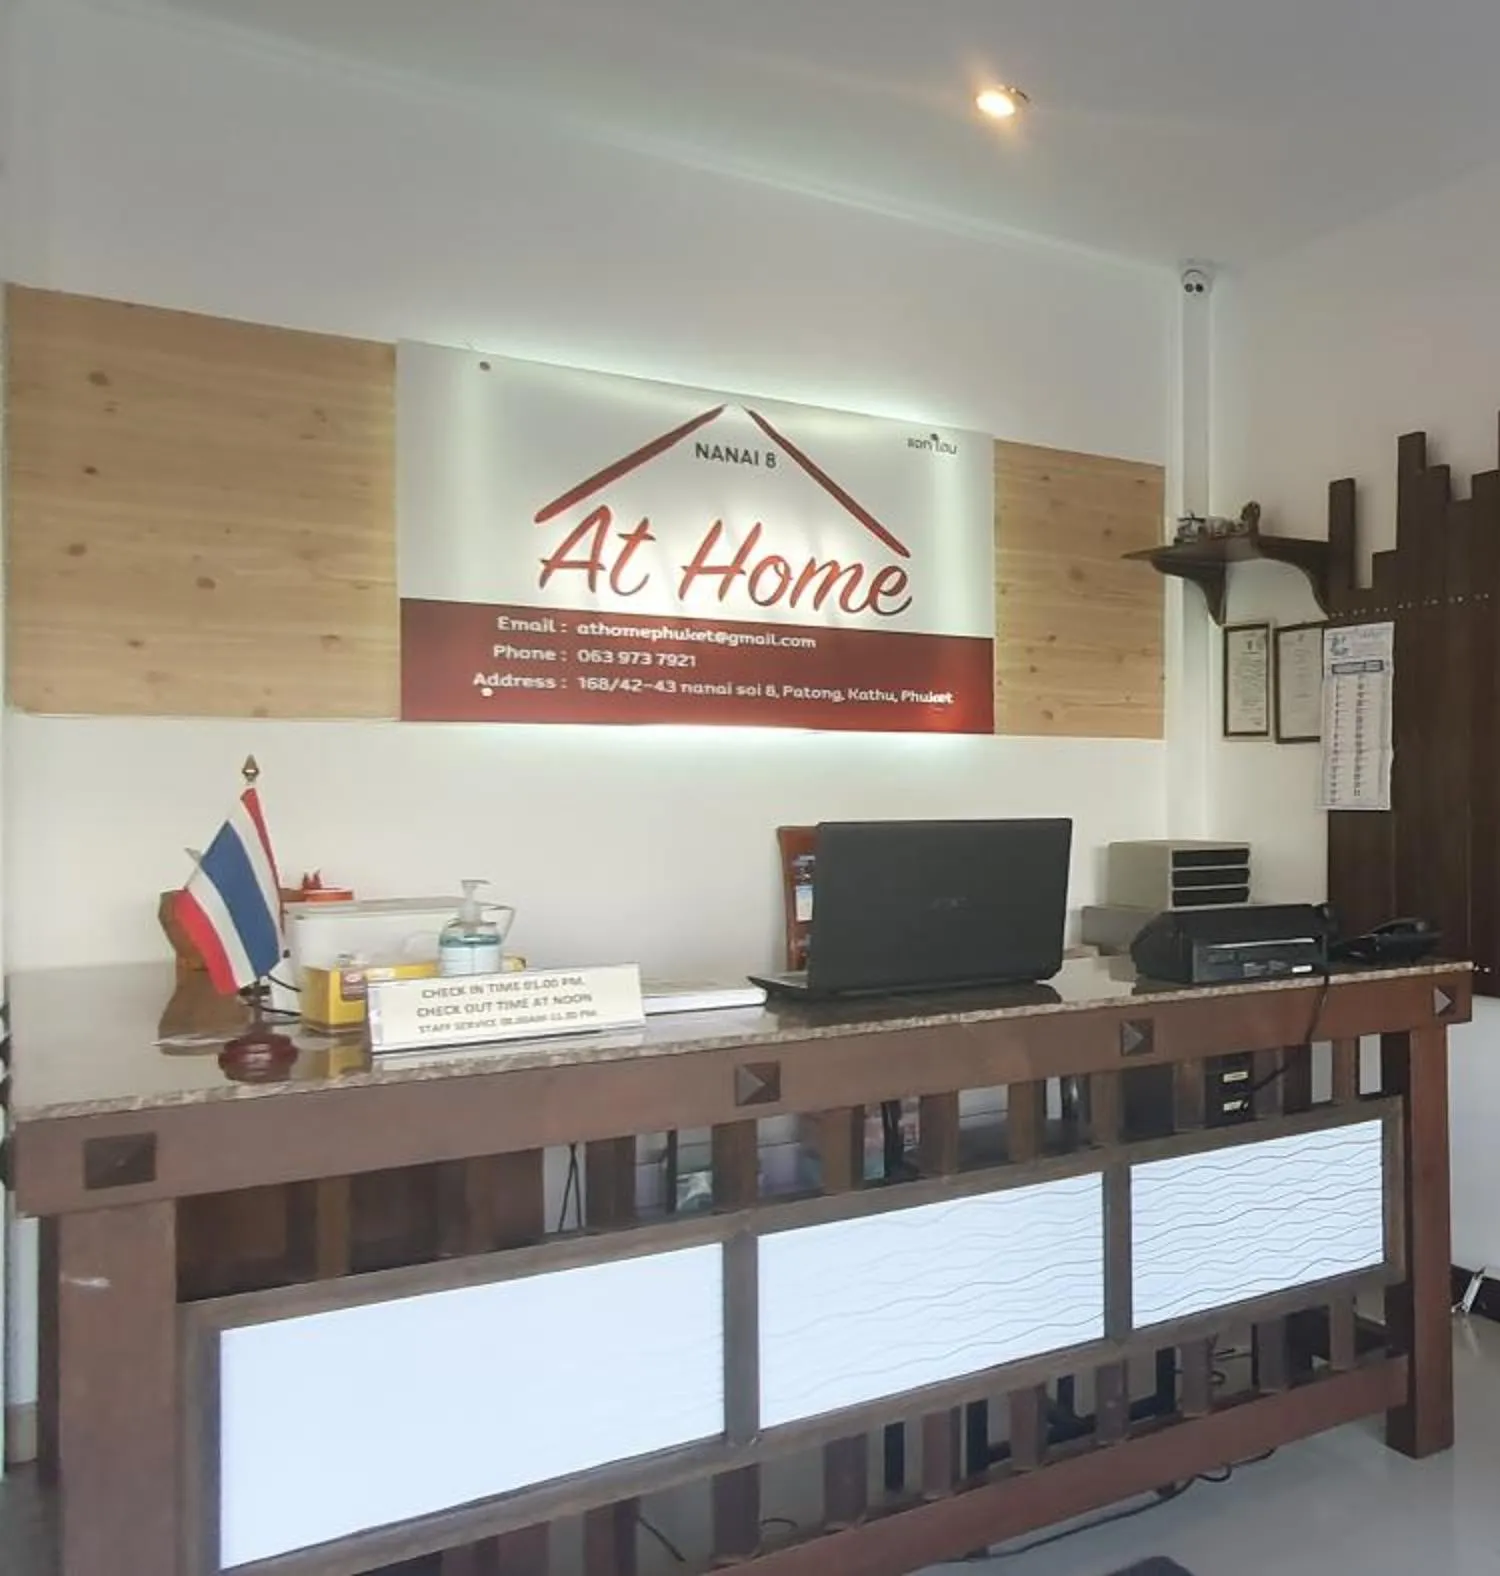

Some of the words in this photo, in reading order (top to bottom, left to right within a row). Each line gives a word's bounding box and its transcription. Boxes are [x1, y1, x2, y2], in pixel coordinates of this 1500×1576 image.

[695, 442, 762, 467] NANAI
[764, 452, 777, 470] 8
[538, 504, 656, 597] At
[678, 519, 913, 617] Home
[497, 616, 556, 633] Email
[577, 621, 817, 648] athomephuket@gmail.com
[493, 644, 556, 661] Phone
[577, 649, 613, 664] 063
[618, 651, 652, 666] 973
[657, 653, 696, 668] 7921
[473, 671, 556, 689] Address
[681, 681, 732, 696] nanai
[736, 682, 761, 697] soi
[783, 685, 845, 703] Patong,
[848, 688, 898, 704] Kathu,
[901, 689, 953, 704] Phuket
[421, 986, 466, 1000] CHECK
[470, 984, 484, 996] IN
[489, 981, 520, 994] TIME
[416, 1006, 461, 1019] CHECK
[465, 1002, 493, 1015] OUT
[496, 999, 529, 1012] TIME
[532, 996, 549, 1008] AT
[553, 993, 592, 1006] NOON
[418, 1022, 451, 1034] STAFF
[454, 1018, 496, 1031] SERVICE
